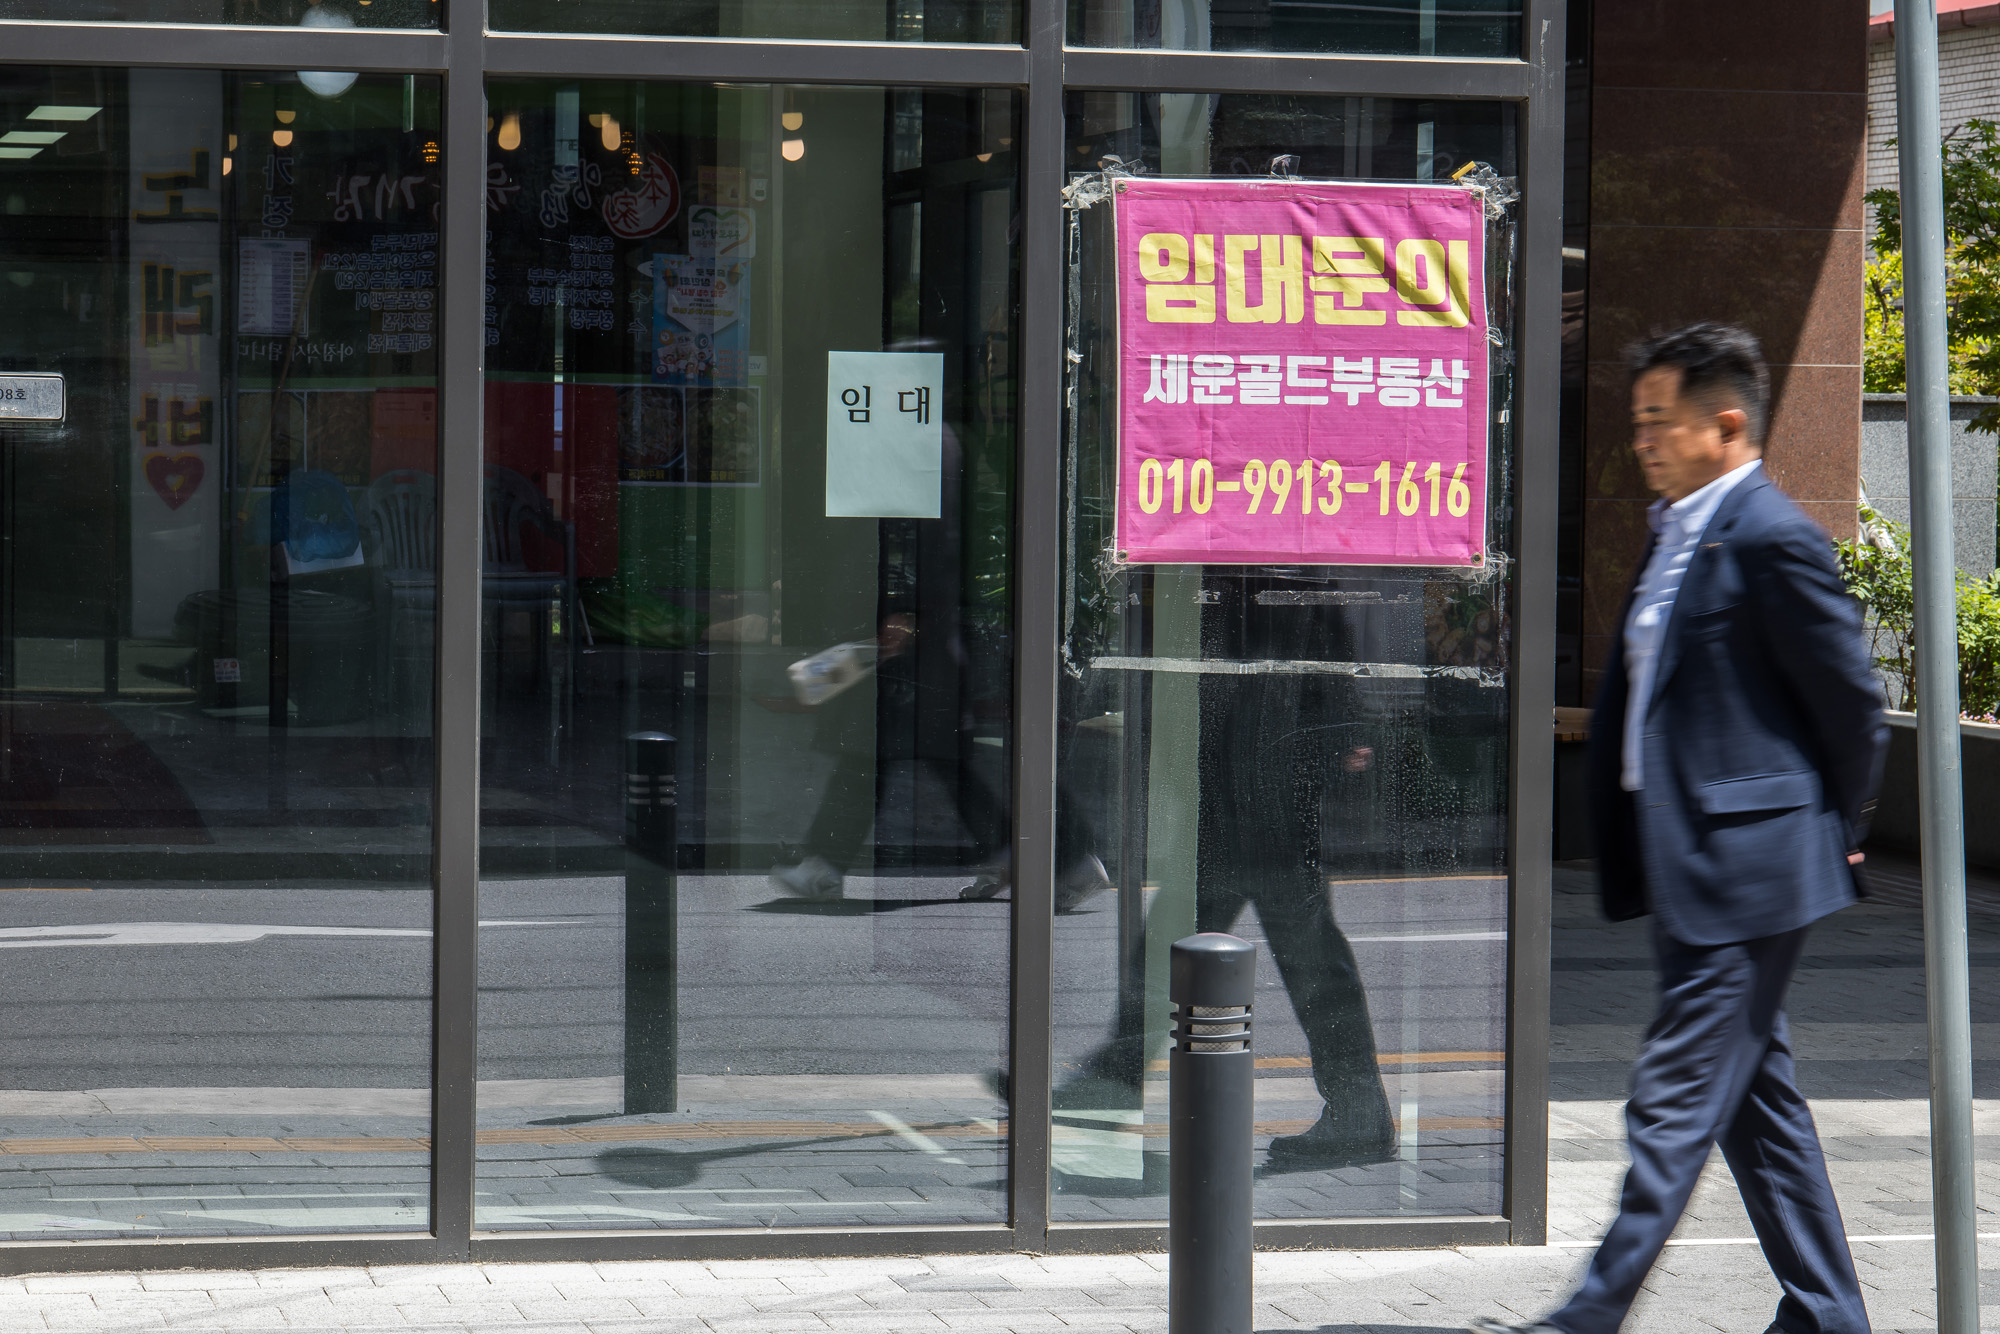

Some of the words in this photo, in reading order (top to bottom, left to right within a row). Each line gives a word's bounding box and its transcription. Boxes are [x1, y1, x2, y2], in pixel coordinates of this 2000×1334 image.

[1138, 232, 1471, 328] 임대문의
[1143, 353, 1470, 408] 세운골드부동산
[1138, 458, 1471, 518] 010-9913-1616
